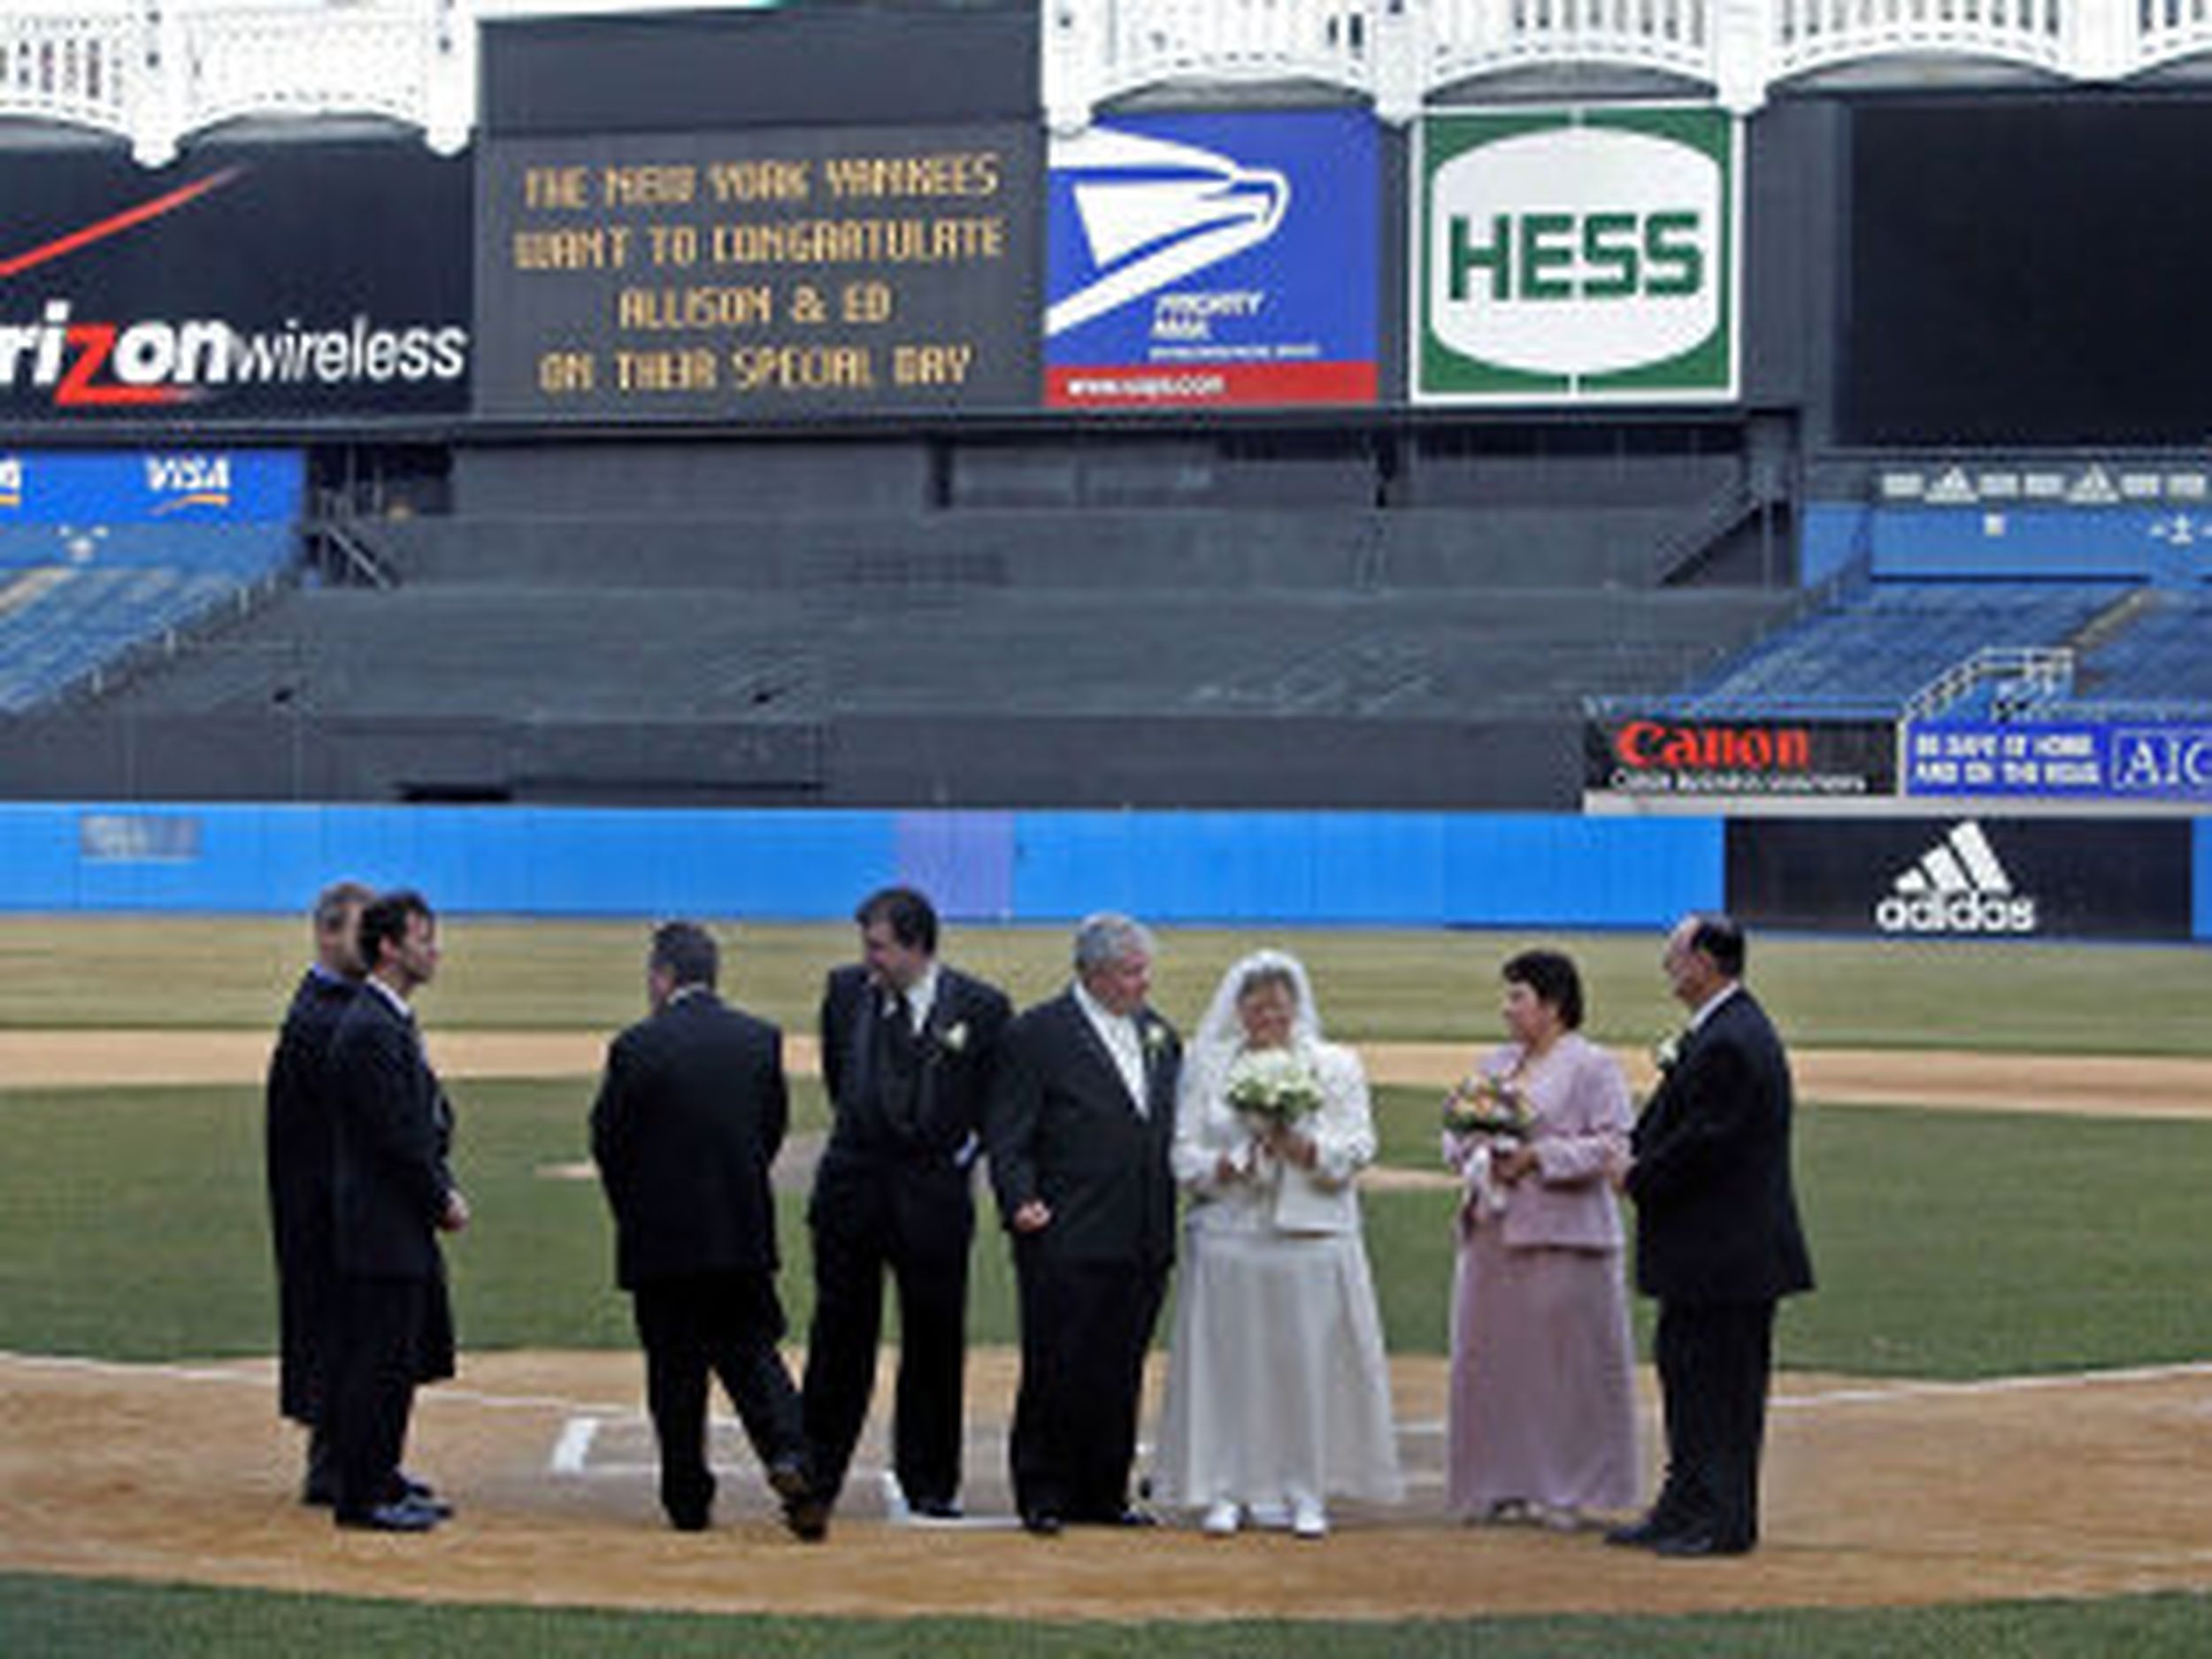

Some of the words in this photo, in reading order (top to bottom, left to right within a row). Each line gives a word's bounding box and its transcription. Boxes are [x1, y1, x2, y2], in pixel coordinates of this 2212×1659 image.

[526, 168, 587, 208] THE
[604, 166, 695, 206] NEW
[708, 162, 810, 201] YORK
[826, 154, 1000, 196] YANKEES
[514, 227, 628, 269] WANT
[651, 226, 697, 265] TO
[713, 217, 1004, 265] CONGRATULATE
[1448, 212, 1702, 302] HESS
[619, 287, 772, 329] ALLISON
[792, 285, 826, 323] &
[843, 282, 891, 323] ED
[541, 353, 594, 391] ON
[618, 348, 717, 391] THEIR
[733, 347, 874, 388] SPECIAL
[894, 345, 973, 385] DAY
[145, 457, 230, 491] VISA
[1615, 721, 1809, 767] Canon
[1876, 887, 2036, 933] adidas
